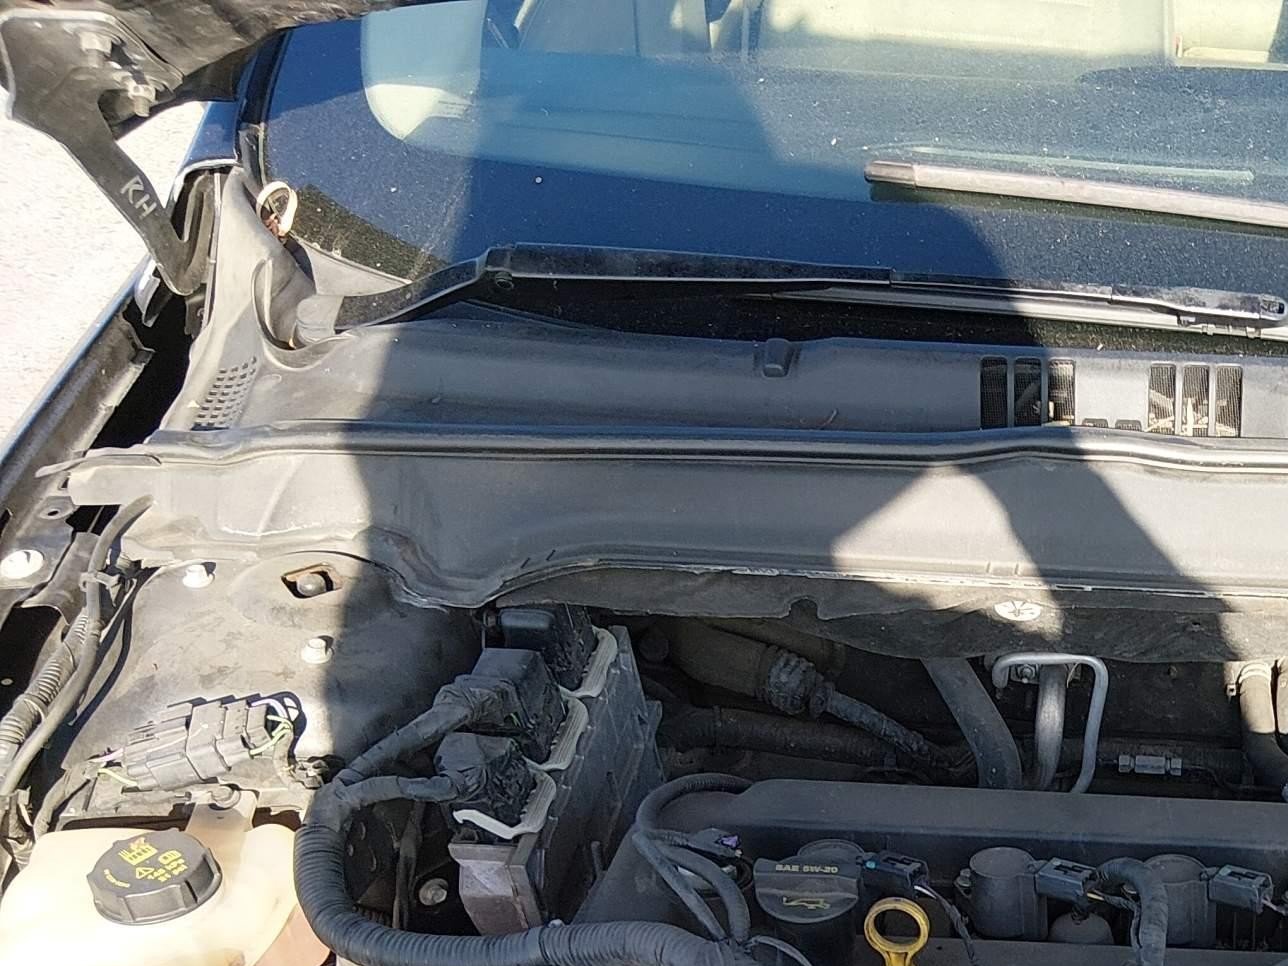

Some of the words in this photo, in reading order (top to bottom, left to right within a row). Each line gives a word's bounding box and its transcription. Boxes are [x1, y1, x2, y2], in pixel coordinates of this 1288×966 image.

[121, 175, 157, 218] RH
[775, 864, 800, 873] SAE
[802, 865, 839, 875] 5W-20
